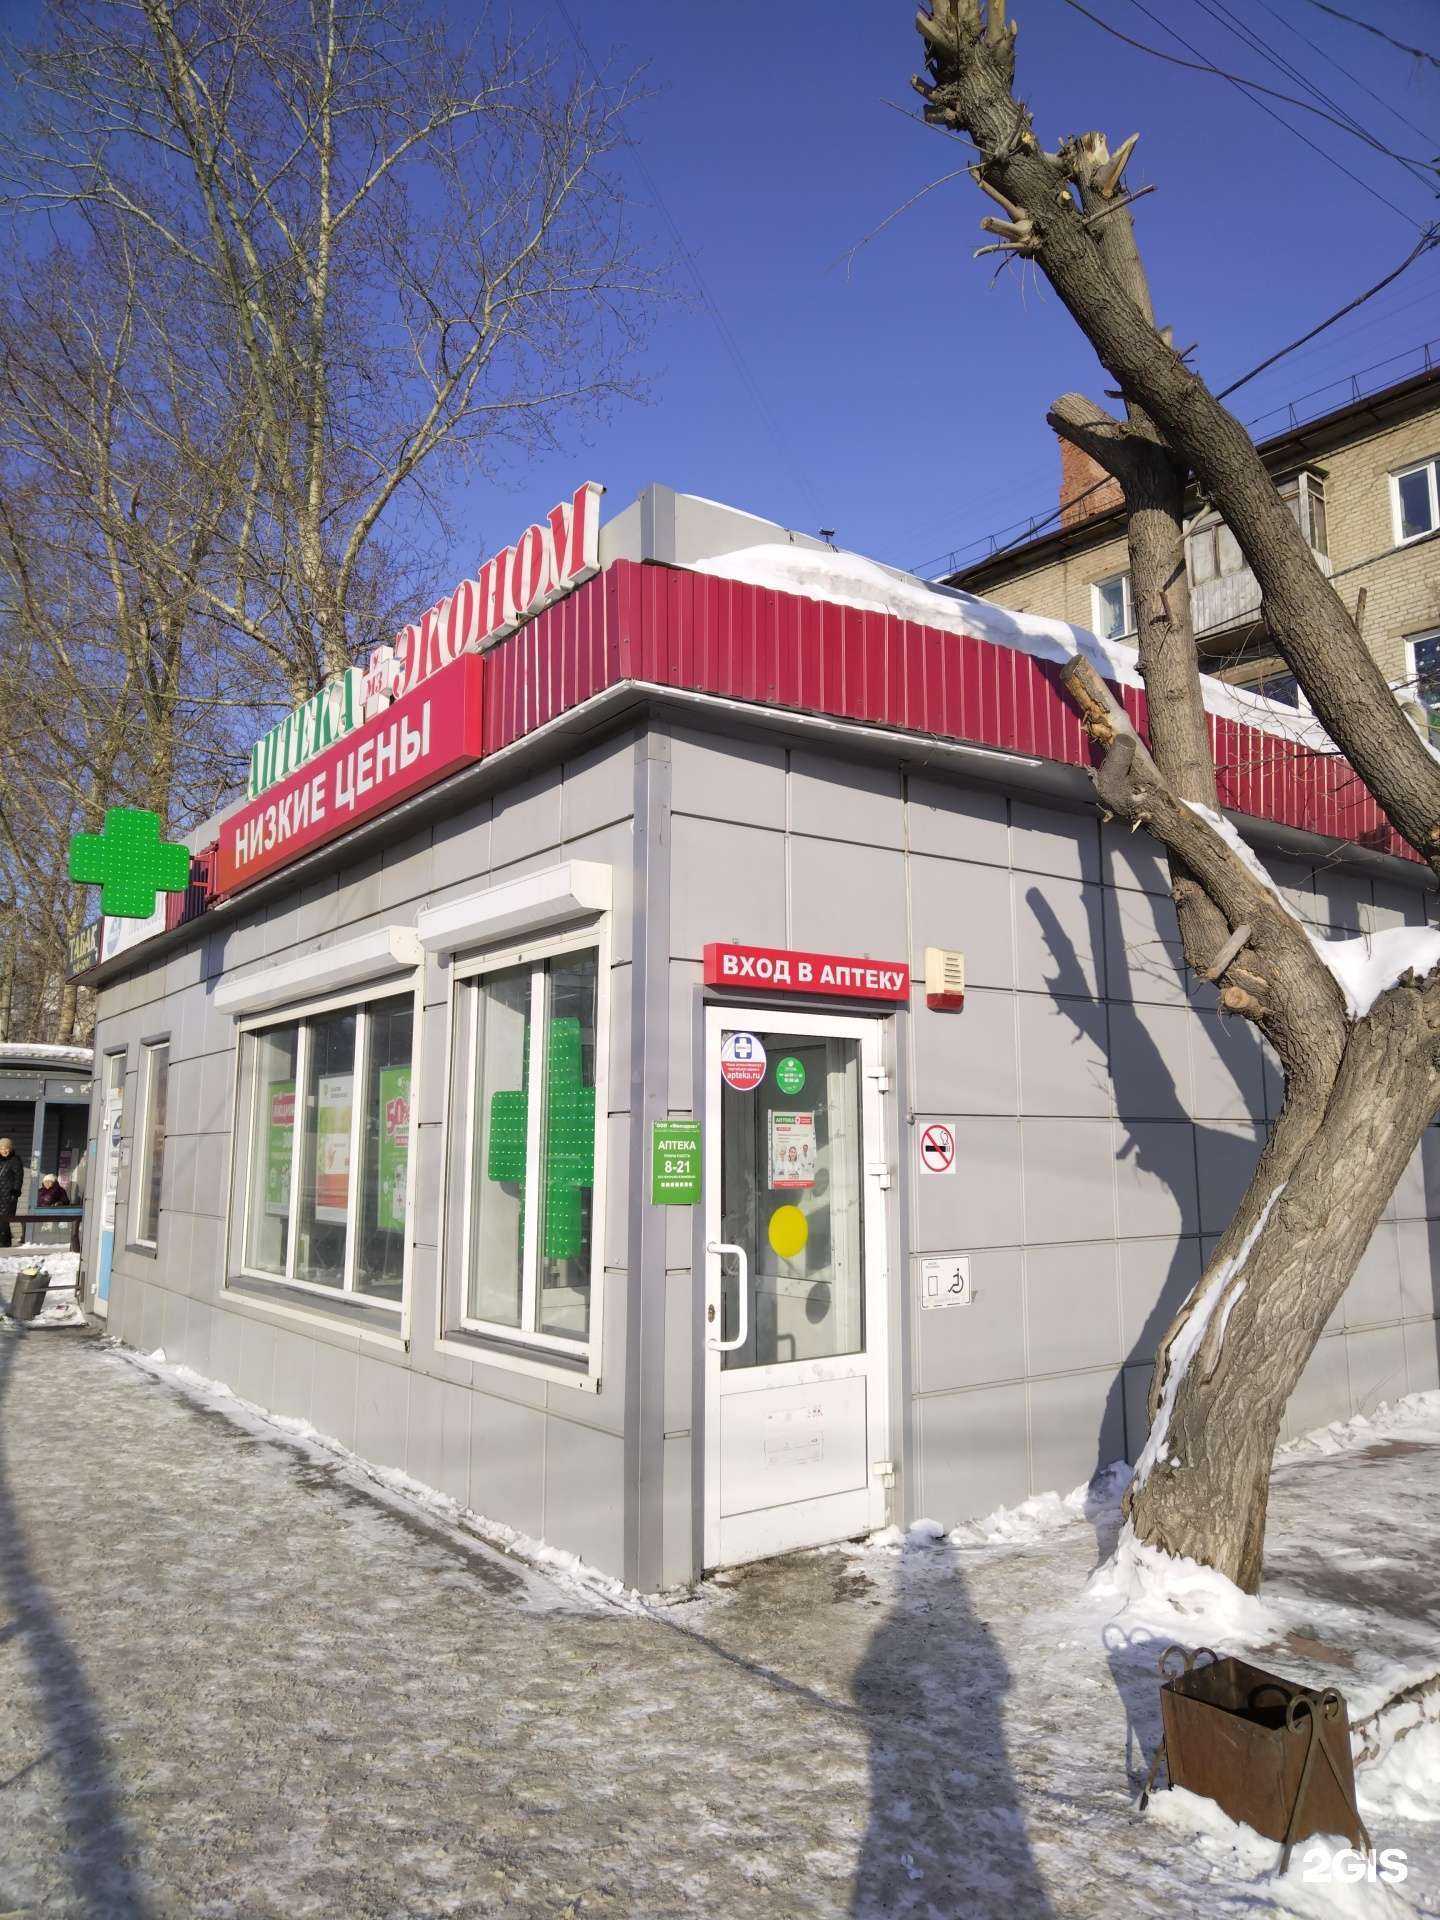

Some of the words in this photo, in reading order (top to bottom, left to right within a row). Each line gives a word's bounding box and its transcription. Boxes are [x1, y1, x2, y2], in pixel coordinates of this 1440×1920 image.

[249, 666, 357, 800] АПТЕКА
[393, 481, 597, 699] ЭКОНОМ
[235, 770, 326, 869] НИЗКИЕ
[335, 700, 431, 812] ЦЕНЫ
[723, 954, 791, 984] ВХОД
[798, 963, 813, 982] В
[820, 964, 904, 991] АПТЕКУ
[727, 1070, 760, 1081] apteka.ru
[657, 1140, 697, 1150] АПТЕКА
[664, 1160, 691, 1173] 8-21
